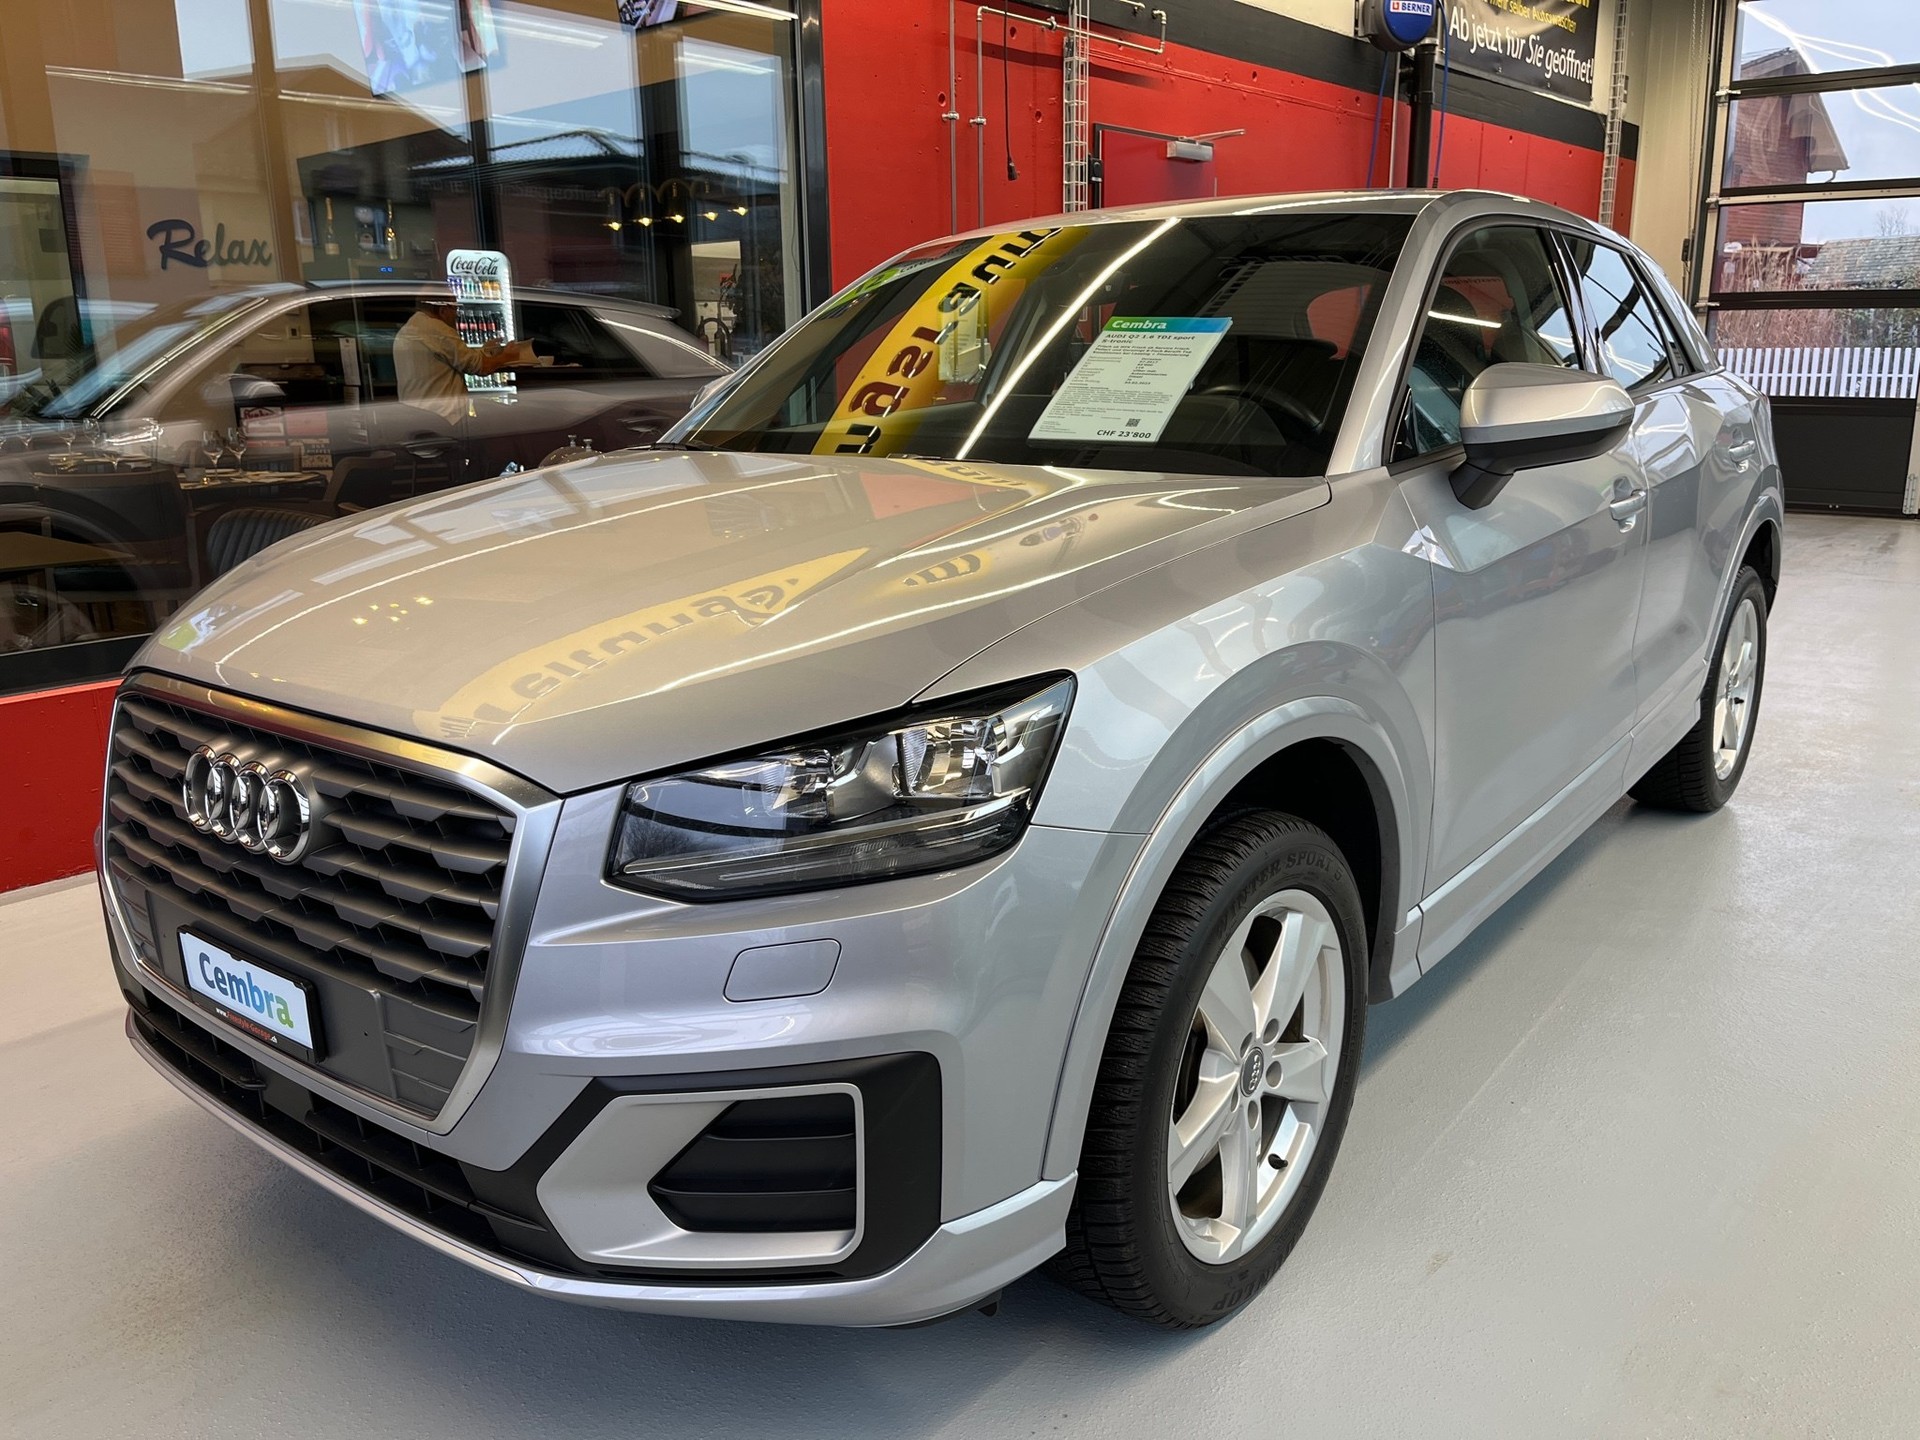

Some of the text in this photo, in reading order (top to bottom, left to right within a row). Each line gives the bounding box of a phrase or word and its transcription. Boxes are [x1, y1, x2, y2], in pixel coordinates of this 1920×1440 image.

[1401, 1, 1431, 14] BERNER
[1449, 6, 1595, 85] Ab jetzt für Sie geöffnet!
[146, 218, 273, 271] Relax
[450, 255, 500, 276] Coca-Cola
[1111, 320, 1168, 329] Cembra
[1096, 429, 1152, 439] CHF 23'800
[1285, 851, 1334, 872] SPORT
[198, 951, 294, 1029] Cembra
